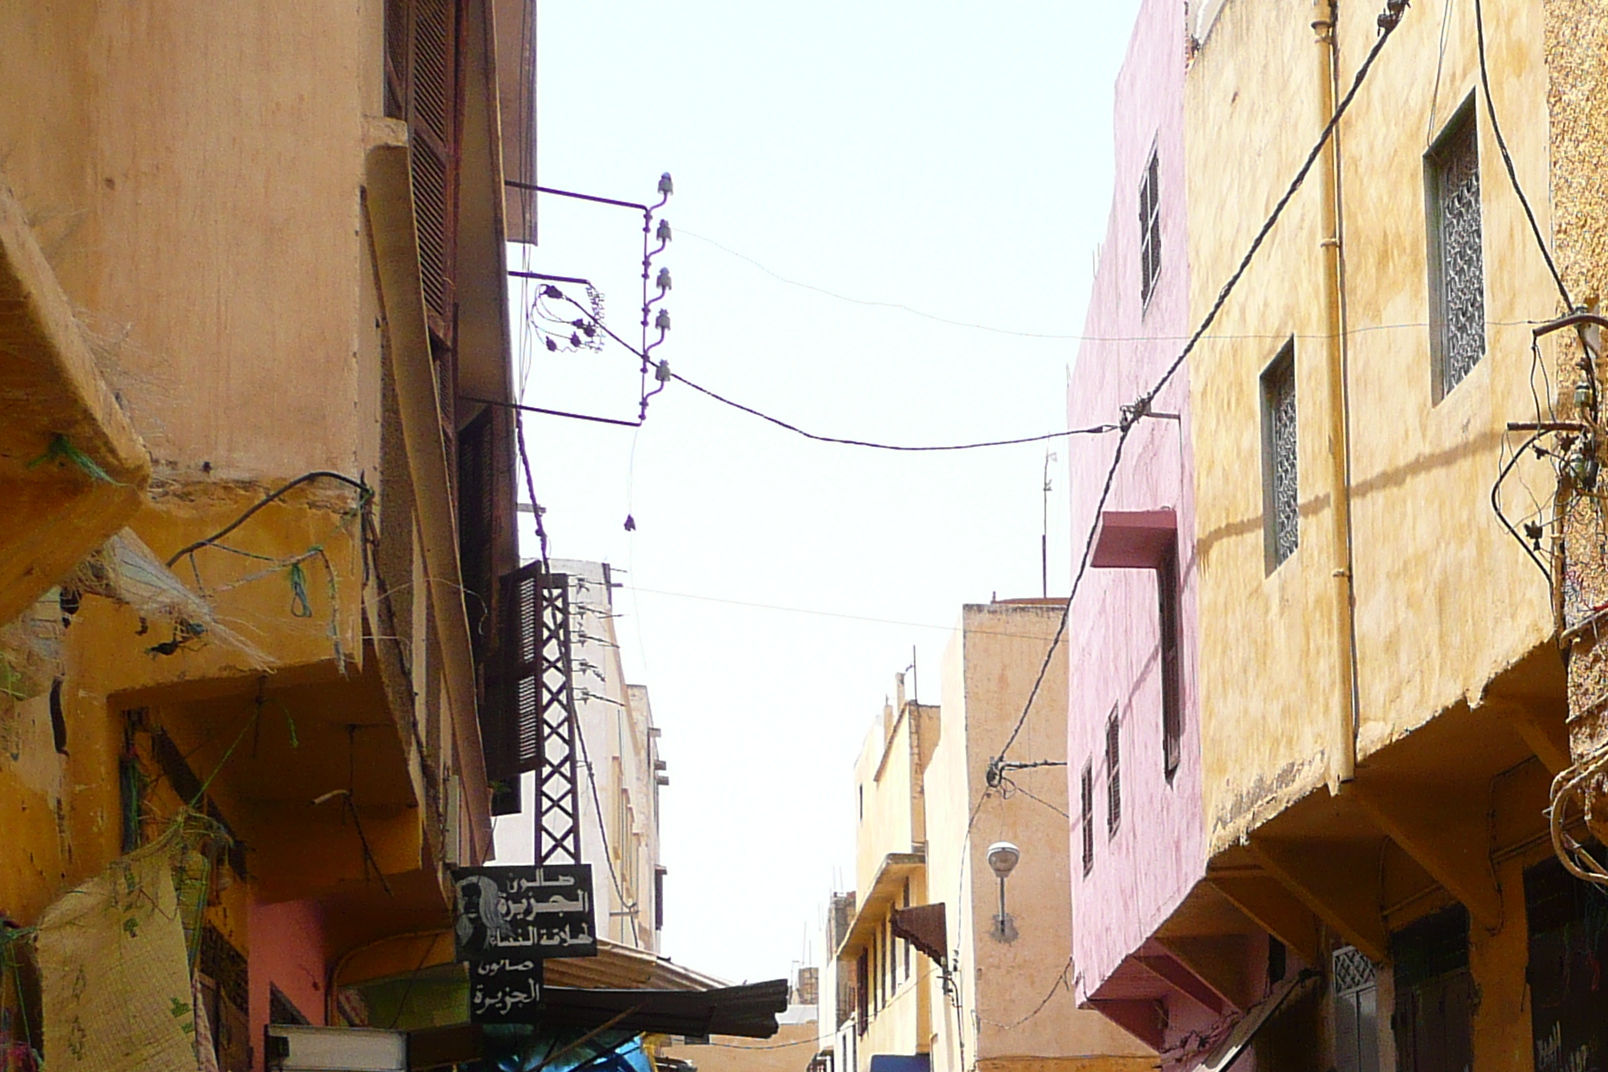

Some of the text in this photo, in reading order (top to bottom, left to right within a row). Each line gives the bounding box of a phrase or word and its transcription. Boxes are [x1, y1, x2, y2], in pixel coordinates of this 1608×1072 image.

[506, 868, 576, 893] صالون
[497, 889, 590, 922] الجزيرة
[489, 925, 538, 947] النساء
[473, 977, 541, 1016] الجزيرة
